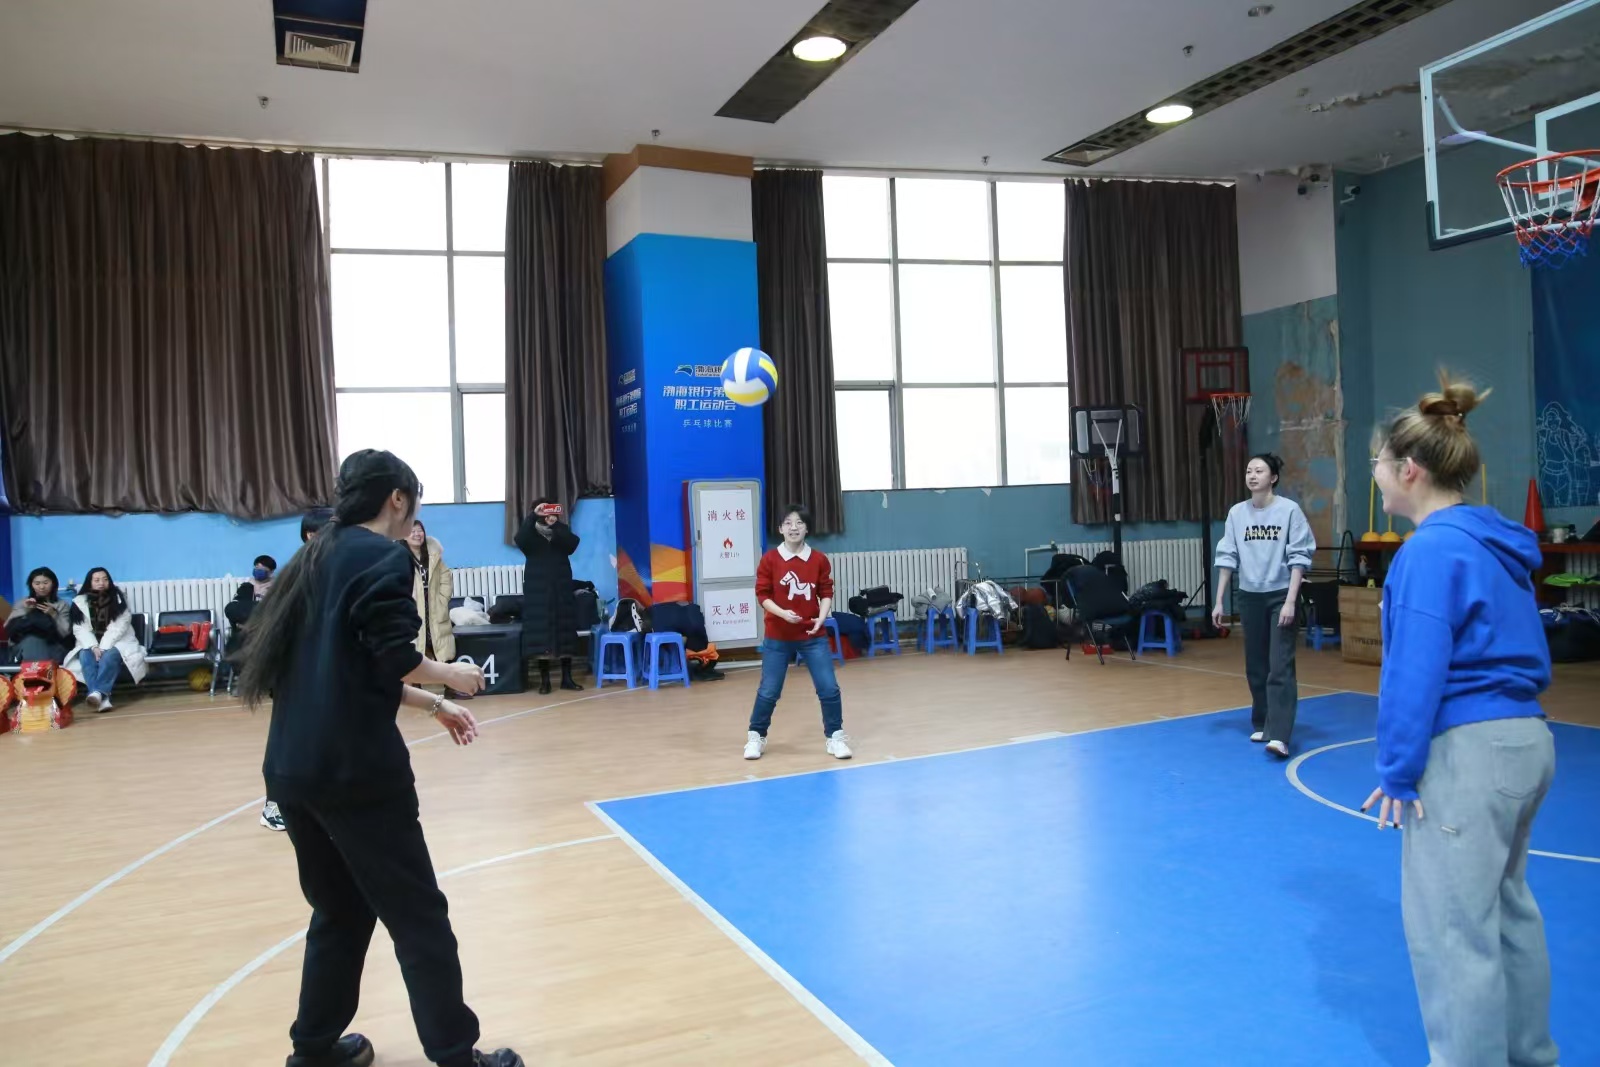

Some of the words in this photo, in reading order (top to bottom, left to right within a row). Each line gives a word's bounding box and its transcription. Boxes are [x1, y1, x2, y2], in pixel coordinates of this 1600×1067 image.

[675, 399, 736, 411] 职工运动会
[683, 419, 732, 428] 乒乓球比赛
[708, 509, 745, 521] 消火栓
[1244, 525, 1281, 541] ARMY
[712, 603, 749, 616] 灭火器
[456, 654, 499, 684] 4
